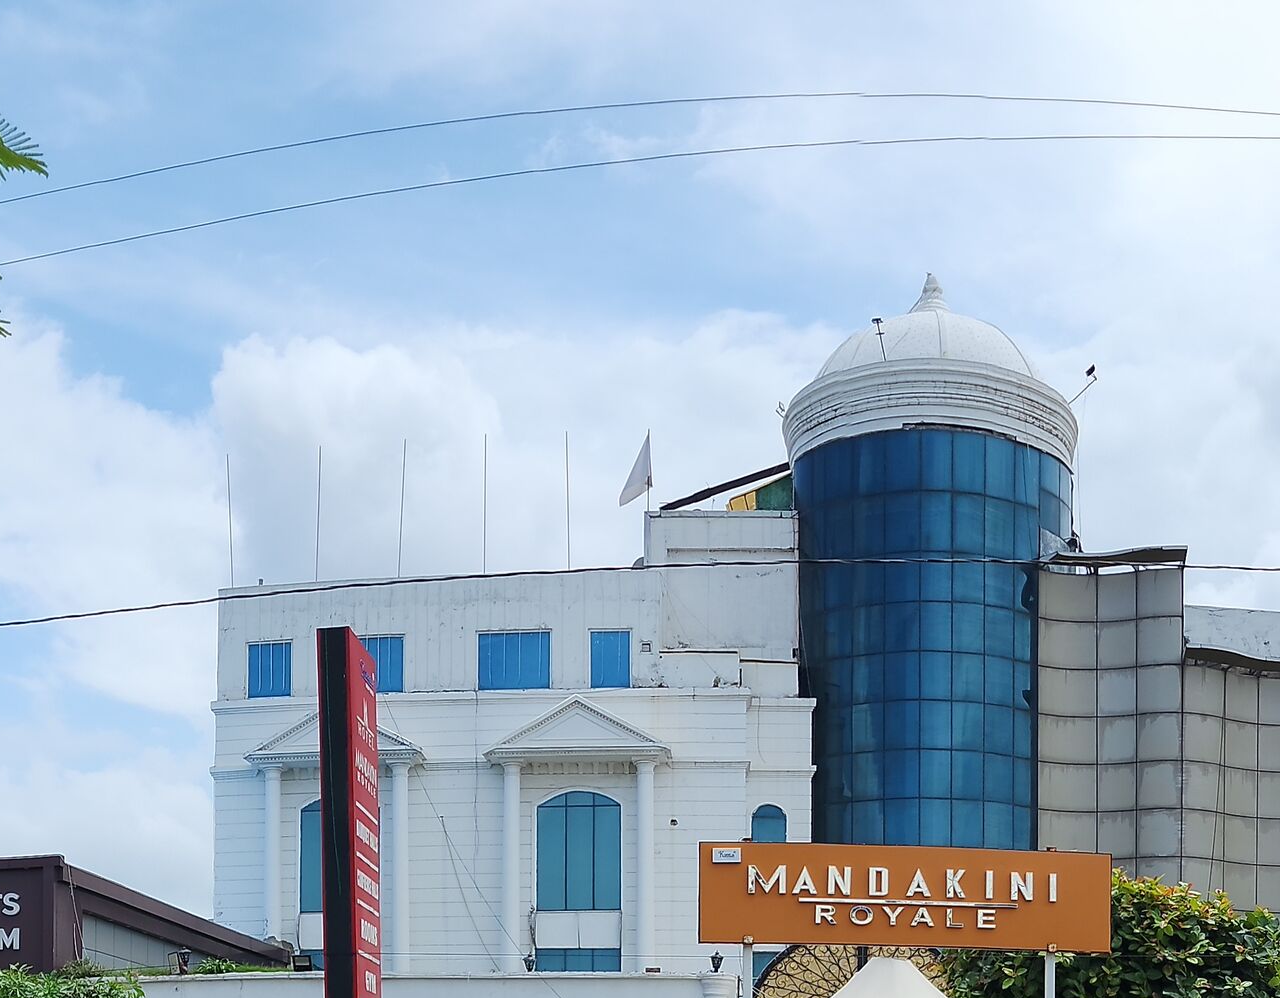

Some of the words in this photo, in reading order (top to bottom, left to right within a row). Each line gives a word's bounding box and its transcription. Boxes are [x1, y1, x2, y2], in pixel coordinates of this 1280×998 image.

[357, 721, 375, 751] HOTEL
[746, 865, 1058, 903] MANDAKINI
[814, 904, 998, 930] ROYALE
